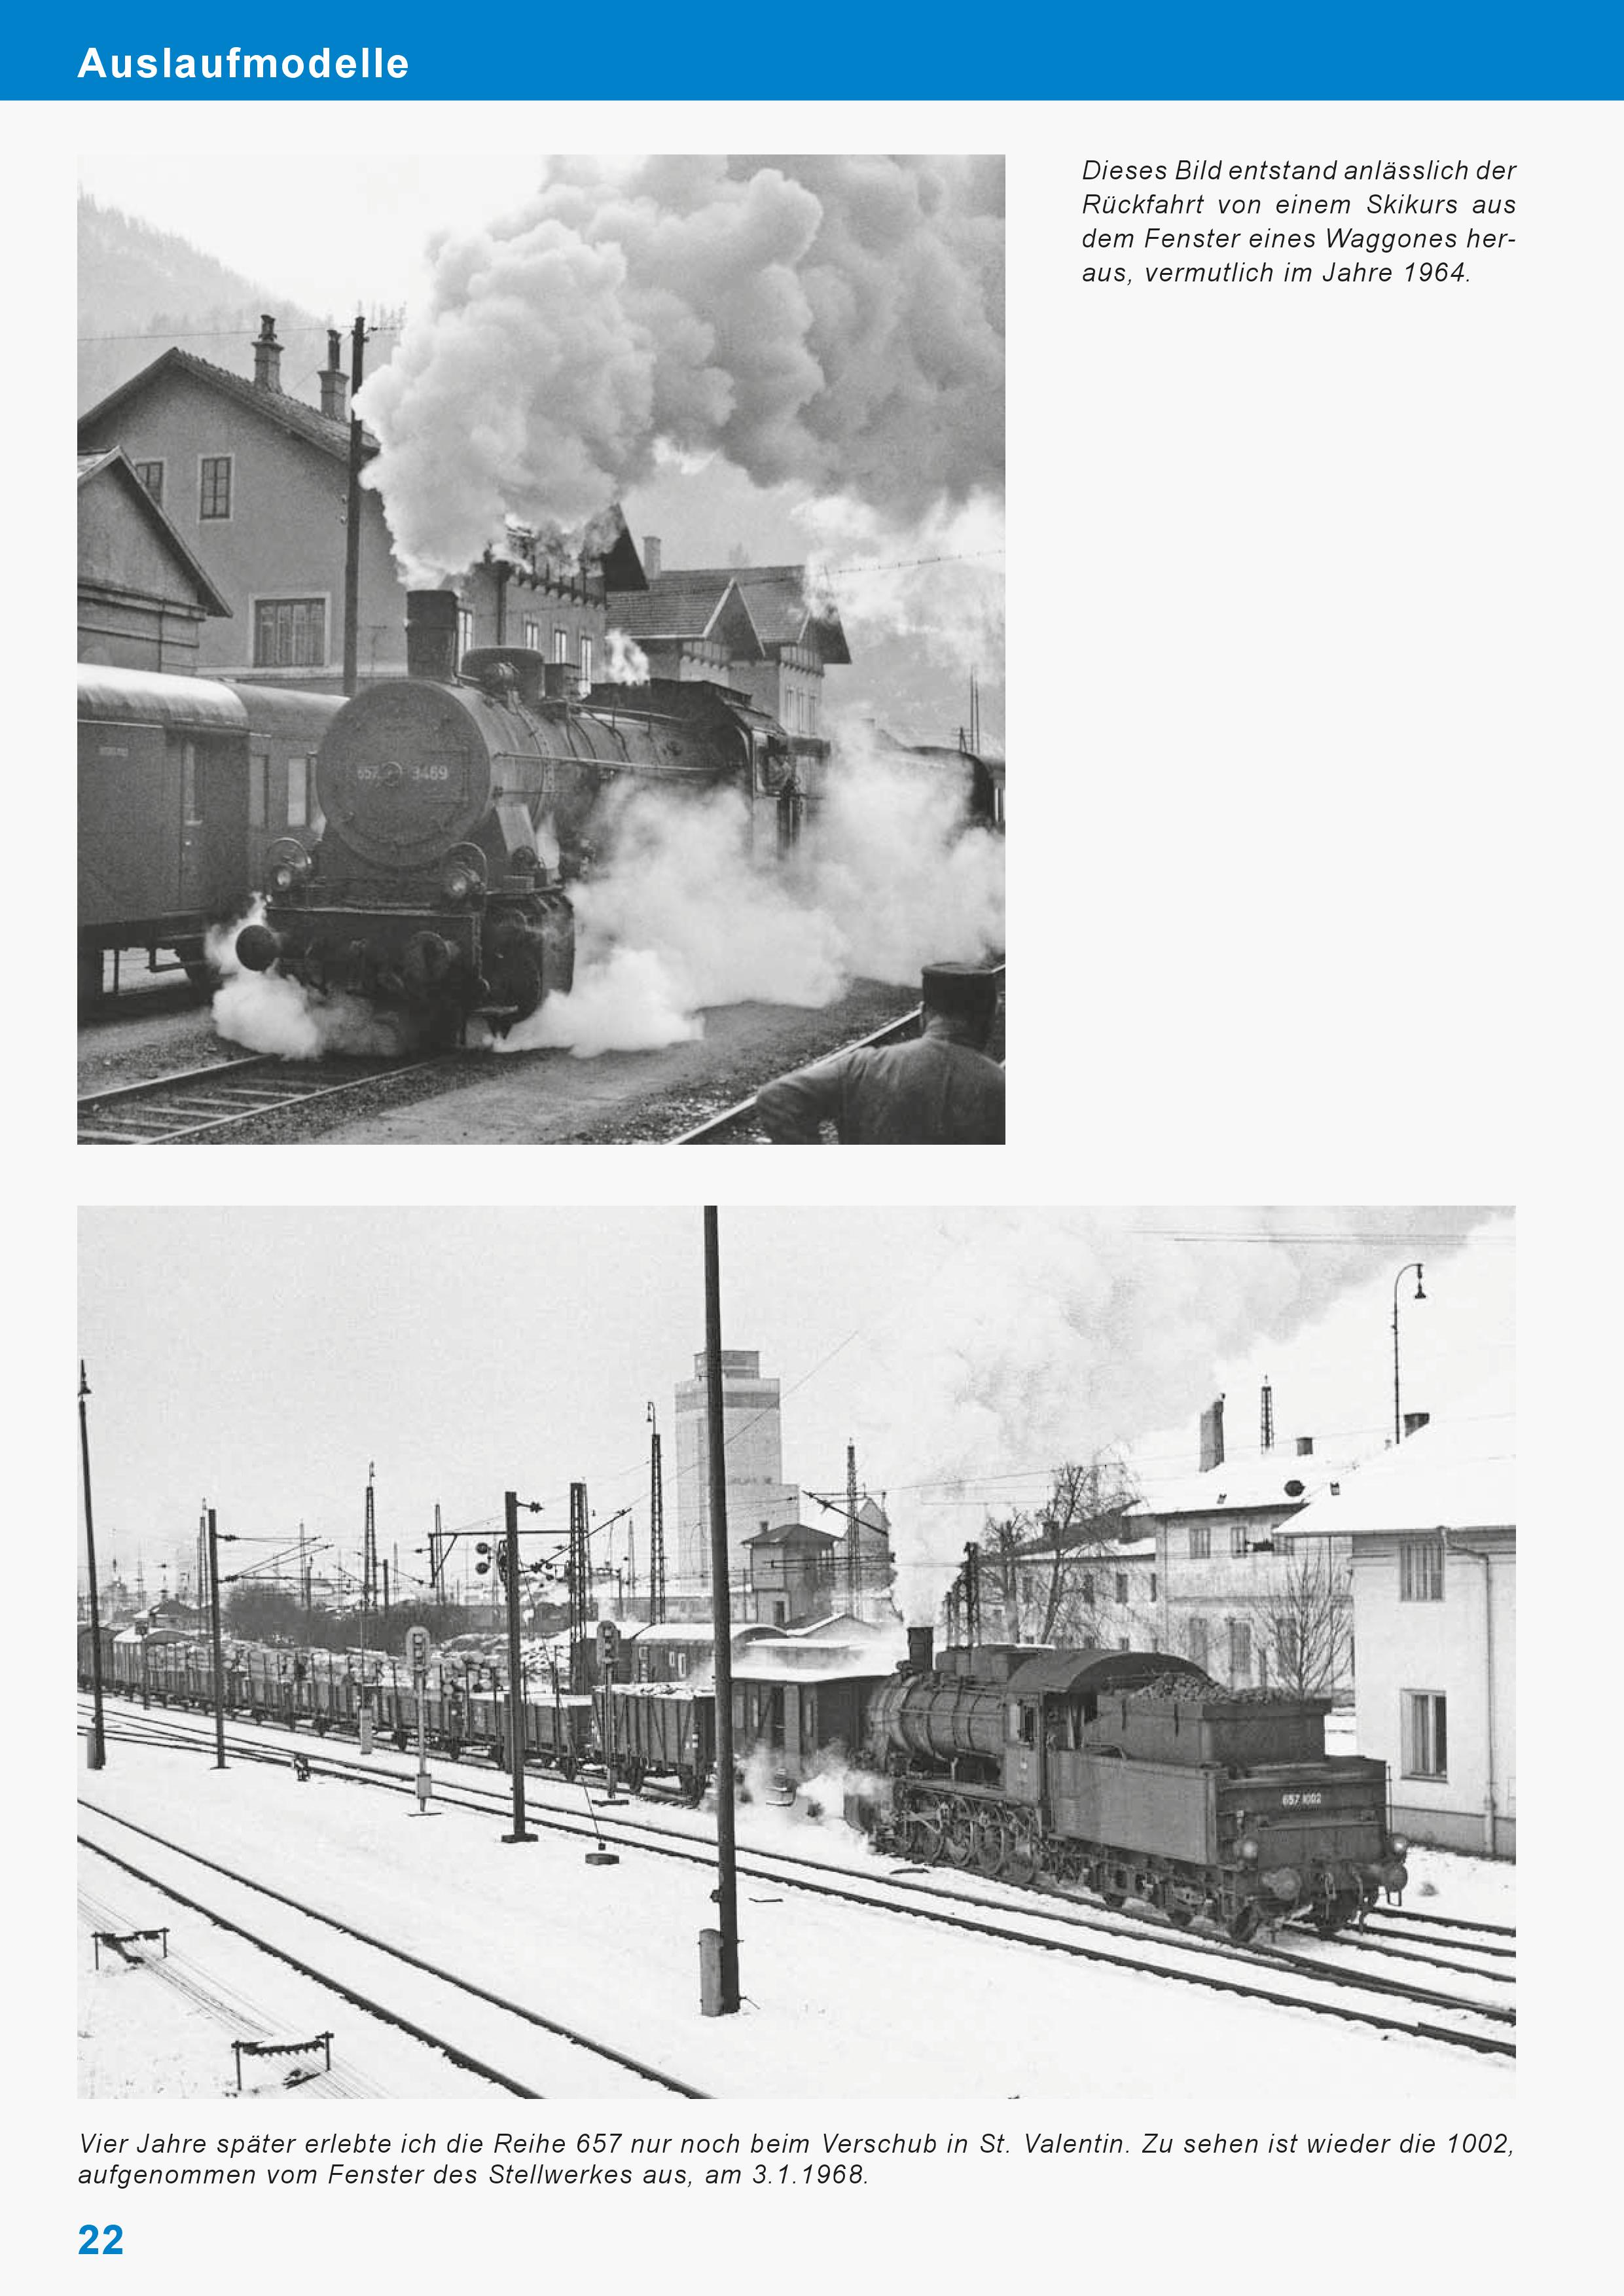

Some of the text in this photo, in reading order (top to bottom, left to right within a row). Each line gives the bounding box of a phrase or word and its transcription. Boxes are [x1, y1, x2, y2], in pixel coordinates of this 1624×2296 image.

[77, 47, 408, 78] Auslaufmodelle
[1083, 160, 1517, 179] Dieses Bild entstand anlässlich der
[1083, 194, 1515, 213] Rückfahrt von einem Skikurs aus
[1083, 228, 1515, 253] dem Fenster eines Waggones her-
[1083, 262, 1469, 285] aus, vermutlich im Jahre 1964.
[411, 765, 448, 781] 3469
[1282, 1794, 1300, 1806] 657
[81, 2134, 1512, 2158] Vier Jahre später erlebte ich die Reihe 657 nur noch beim Verschub in St. Valentin. Zu sehen ist wieder die 1002,
[79, 2164, 867, 2189] aufgenommen vom Fenster des Stellwerkes aus, am 3.1.1968.
[79, 2225, 122, 2254] 22
